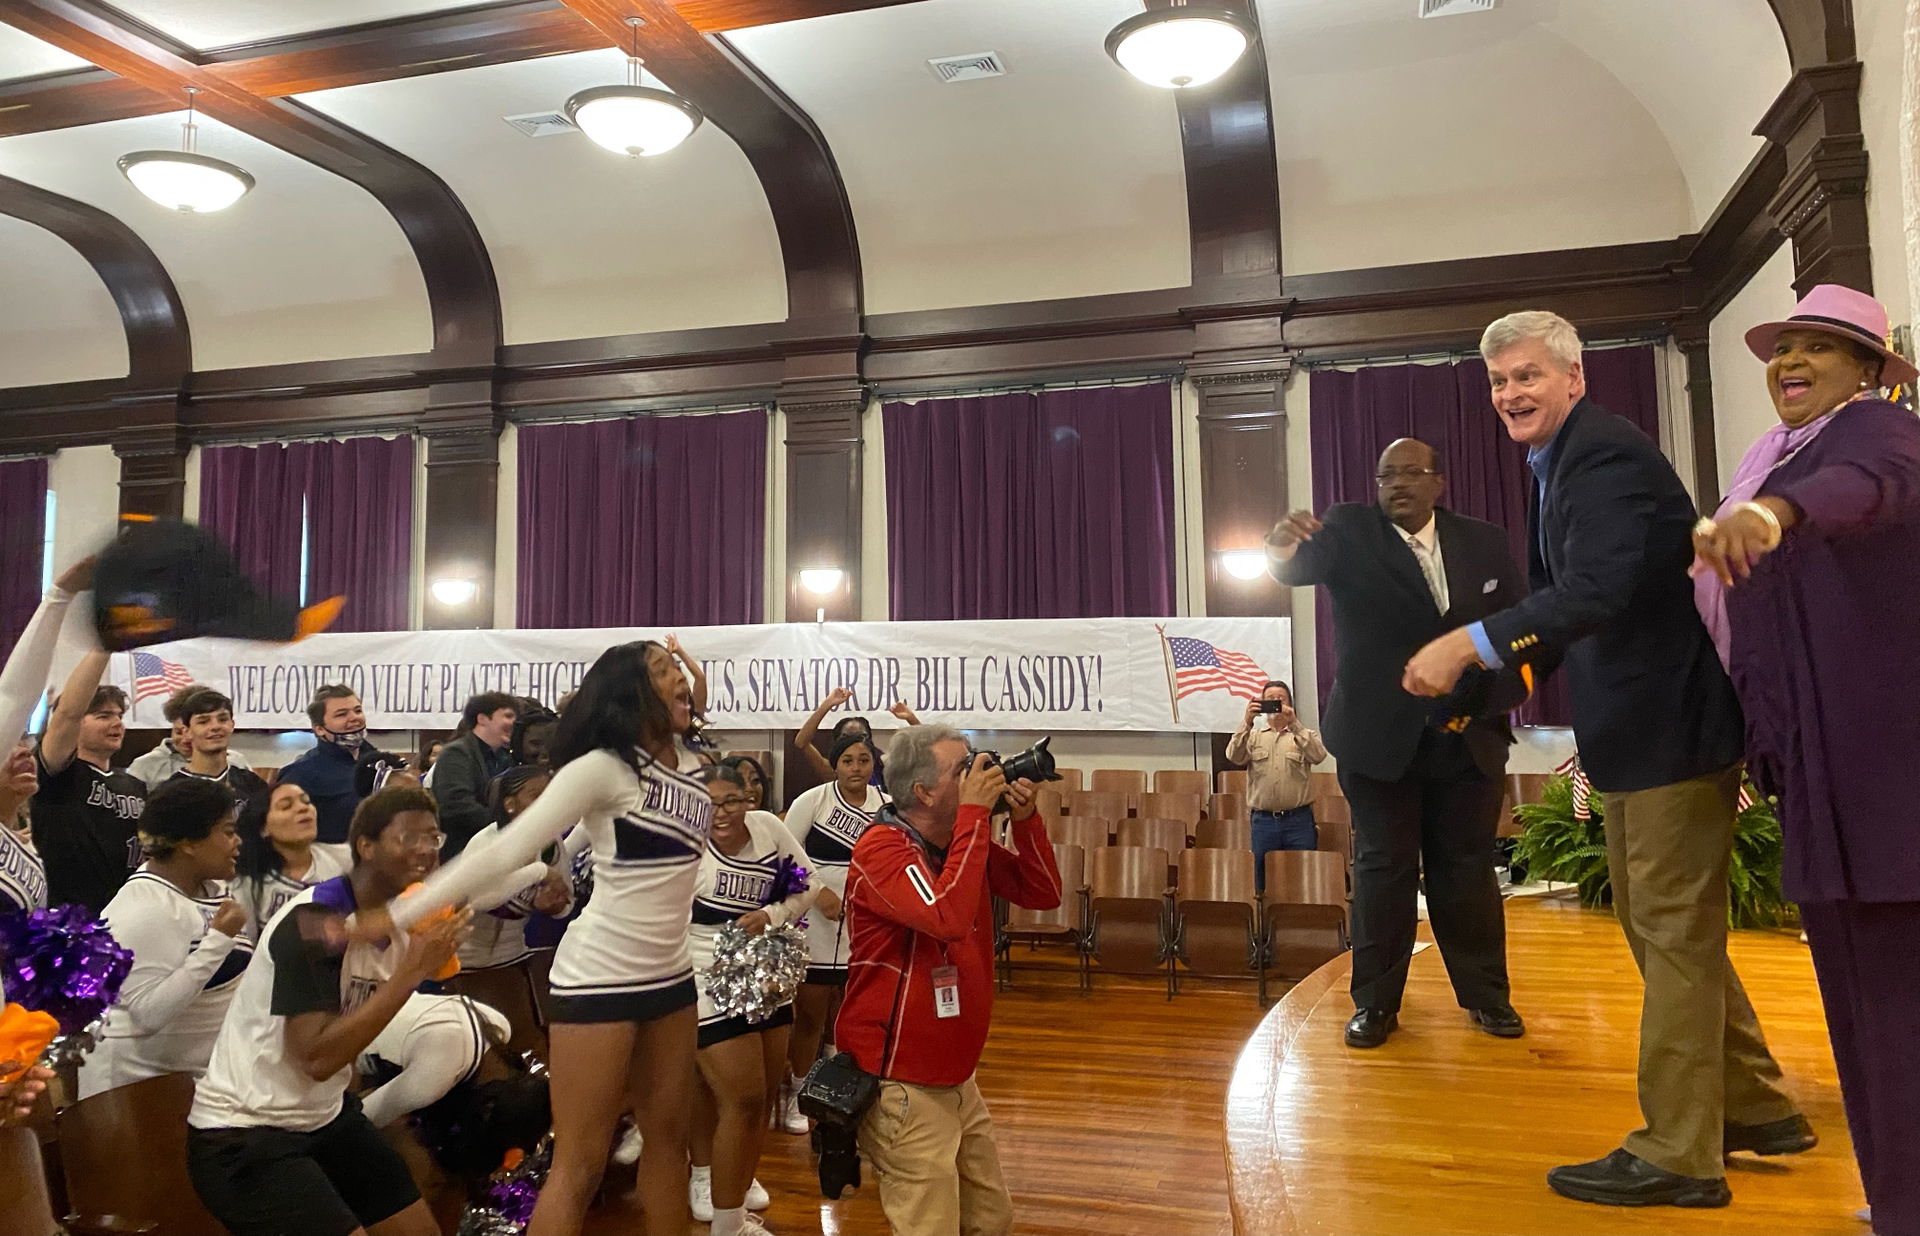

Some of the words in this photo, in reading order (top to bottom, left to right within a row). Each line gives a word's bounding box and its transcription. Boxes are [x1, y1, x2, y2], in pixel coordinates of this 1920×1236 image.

[371, 664, 433, 713] VILLE
[439, 663, 520, 713] PLATTE
[528, 661, 587, 711] HIGH
[701, 658, 740, 713] U.S.
[747, 657, 860, 712] SENATOR
[915, 656, 974, 711] BILL
[980, 654, 1103, 712] CASSIDY!
